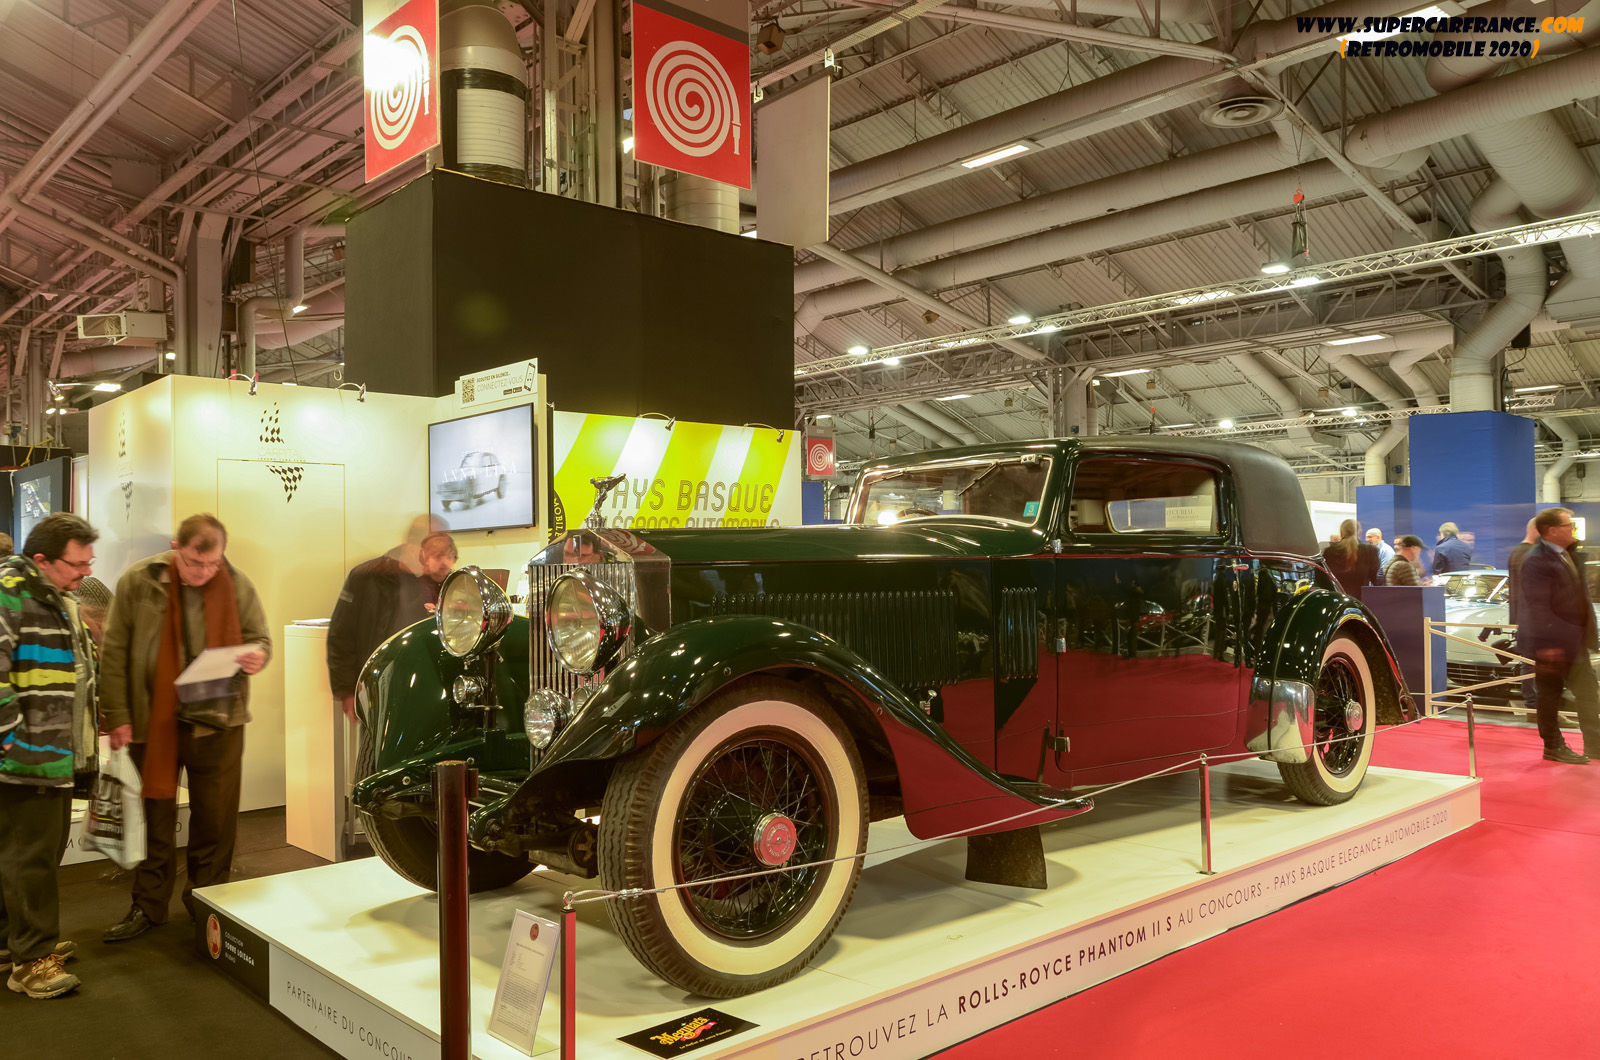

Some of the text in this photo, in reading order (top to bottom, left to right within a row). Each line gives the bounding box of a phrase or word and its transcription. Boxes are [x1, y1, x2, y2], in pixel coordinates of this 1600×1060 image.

[477, 375, 524, 392] CONNECTEZ-VOUS
[597, 477, 774, 513] AYS BASQUE
[927, 1004, 948, 1027] LA
[958, 954, 1072, 1014] ROLLS-ROYCE
[1079, 926, 1147, 966] PHANTOM
[1152, 920, 1160, 937] II
[1166, 916, 1172, 931] S
[1178, 908, 1194, 927] AU
[1199, 882, 1262, 919] CONCOURS
[1274, 870, 1296, 890] PAYS
[1300, 855, 1335, 880] BASQUE
[1338, 837, 1382, 866] ELEGANCE
[1384, 817, 1430, 846] AUTOMOBILE
[1432, 810, 1448, 828] 2020
[286, 981, 337, 1024] PARTENAIRE
[342, 1015, 354, 1034] DU
